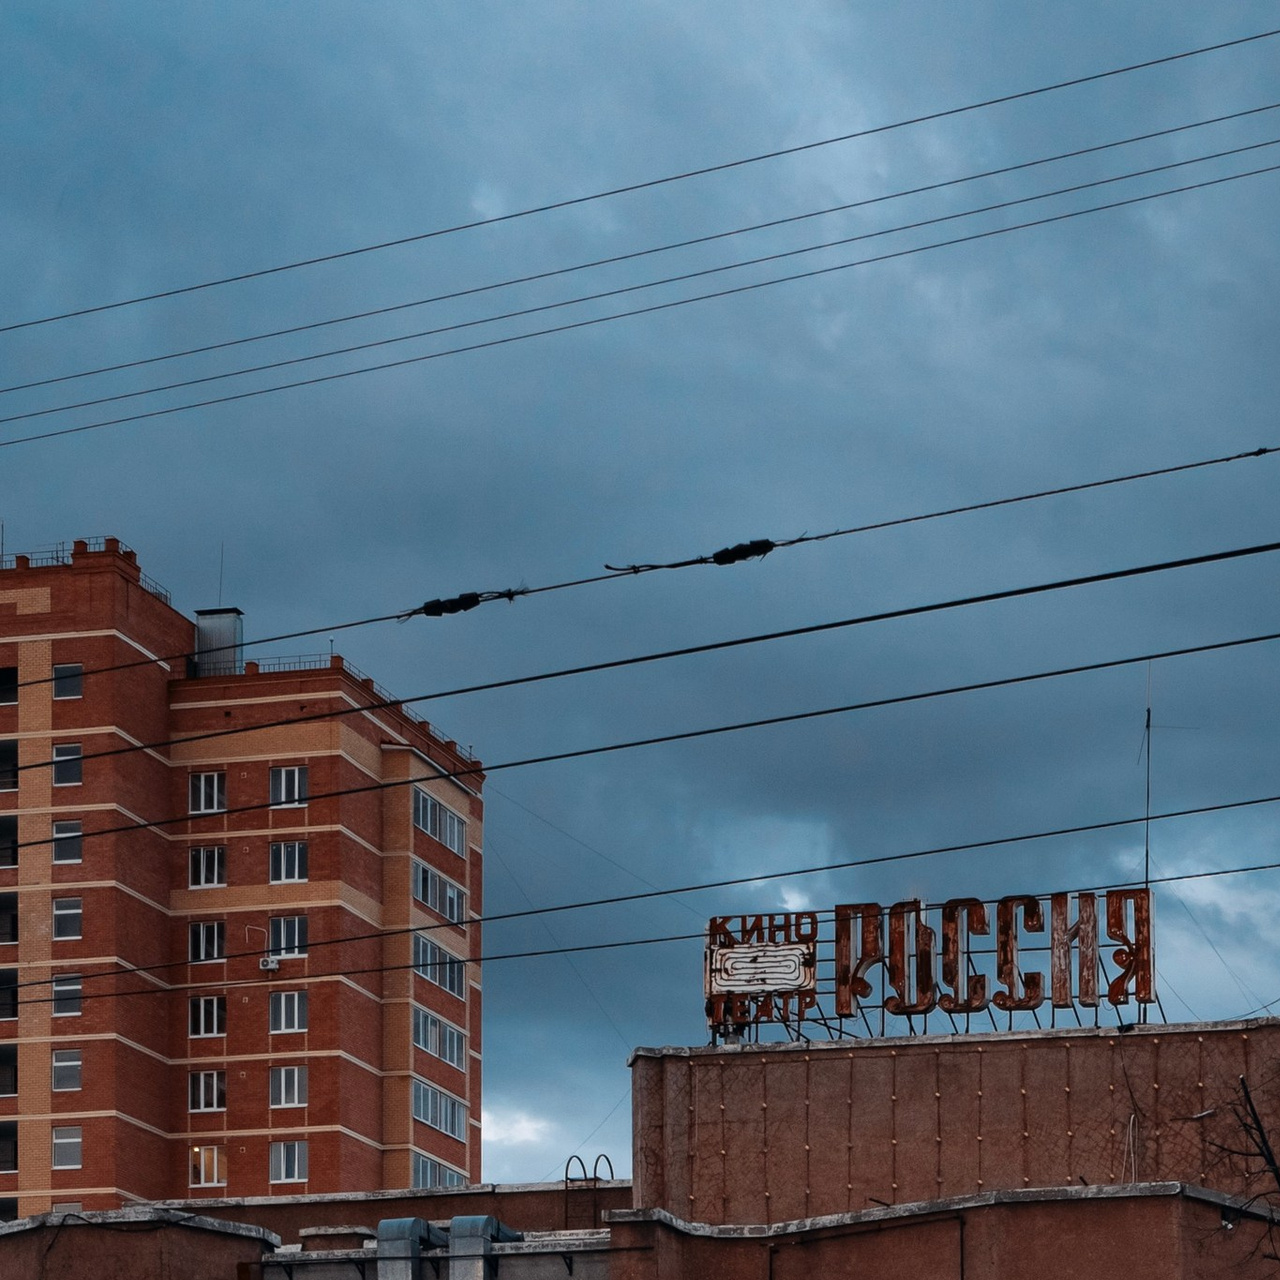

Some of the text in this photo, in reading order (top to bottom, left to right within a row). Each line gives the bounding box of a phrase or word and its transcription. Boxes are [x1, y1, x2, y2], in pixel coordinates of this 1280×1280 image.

[710, 912, 818, 949] КИНО
[835, 888, 1156, 1017] РОССИЯ
[709, 989, 817, 1026] ТЕАТР
